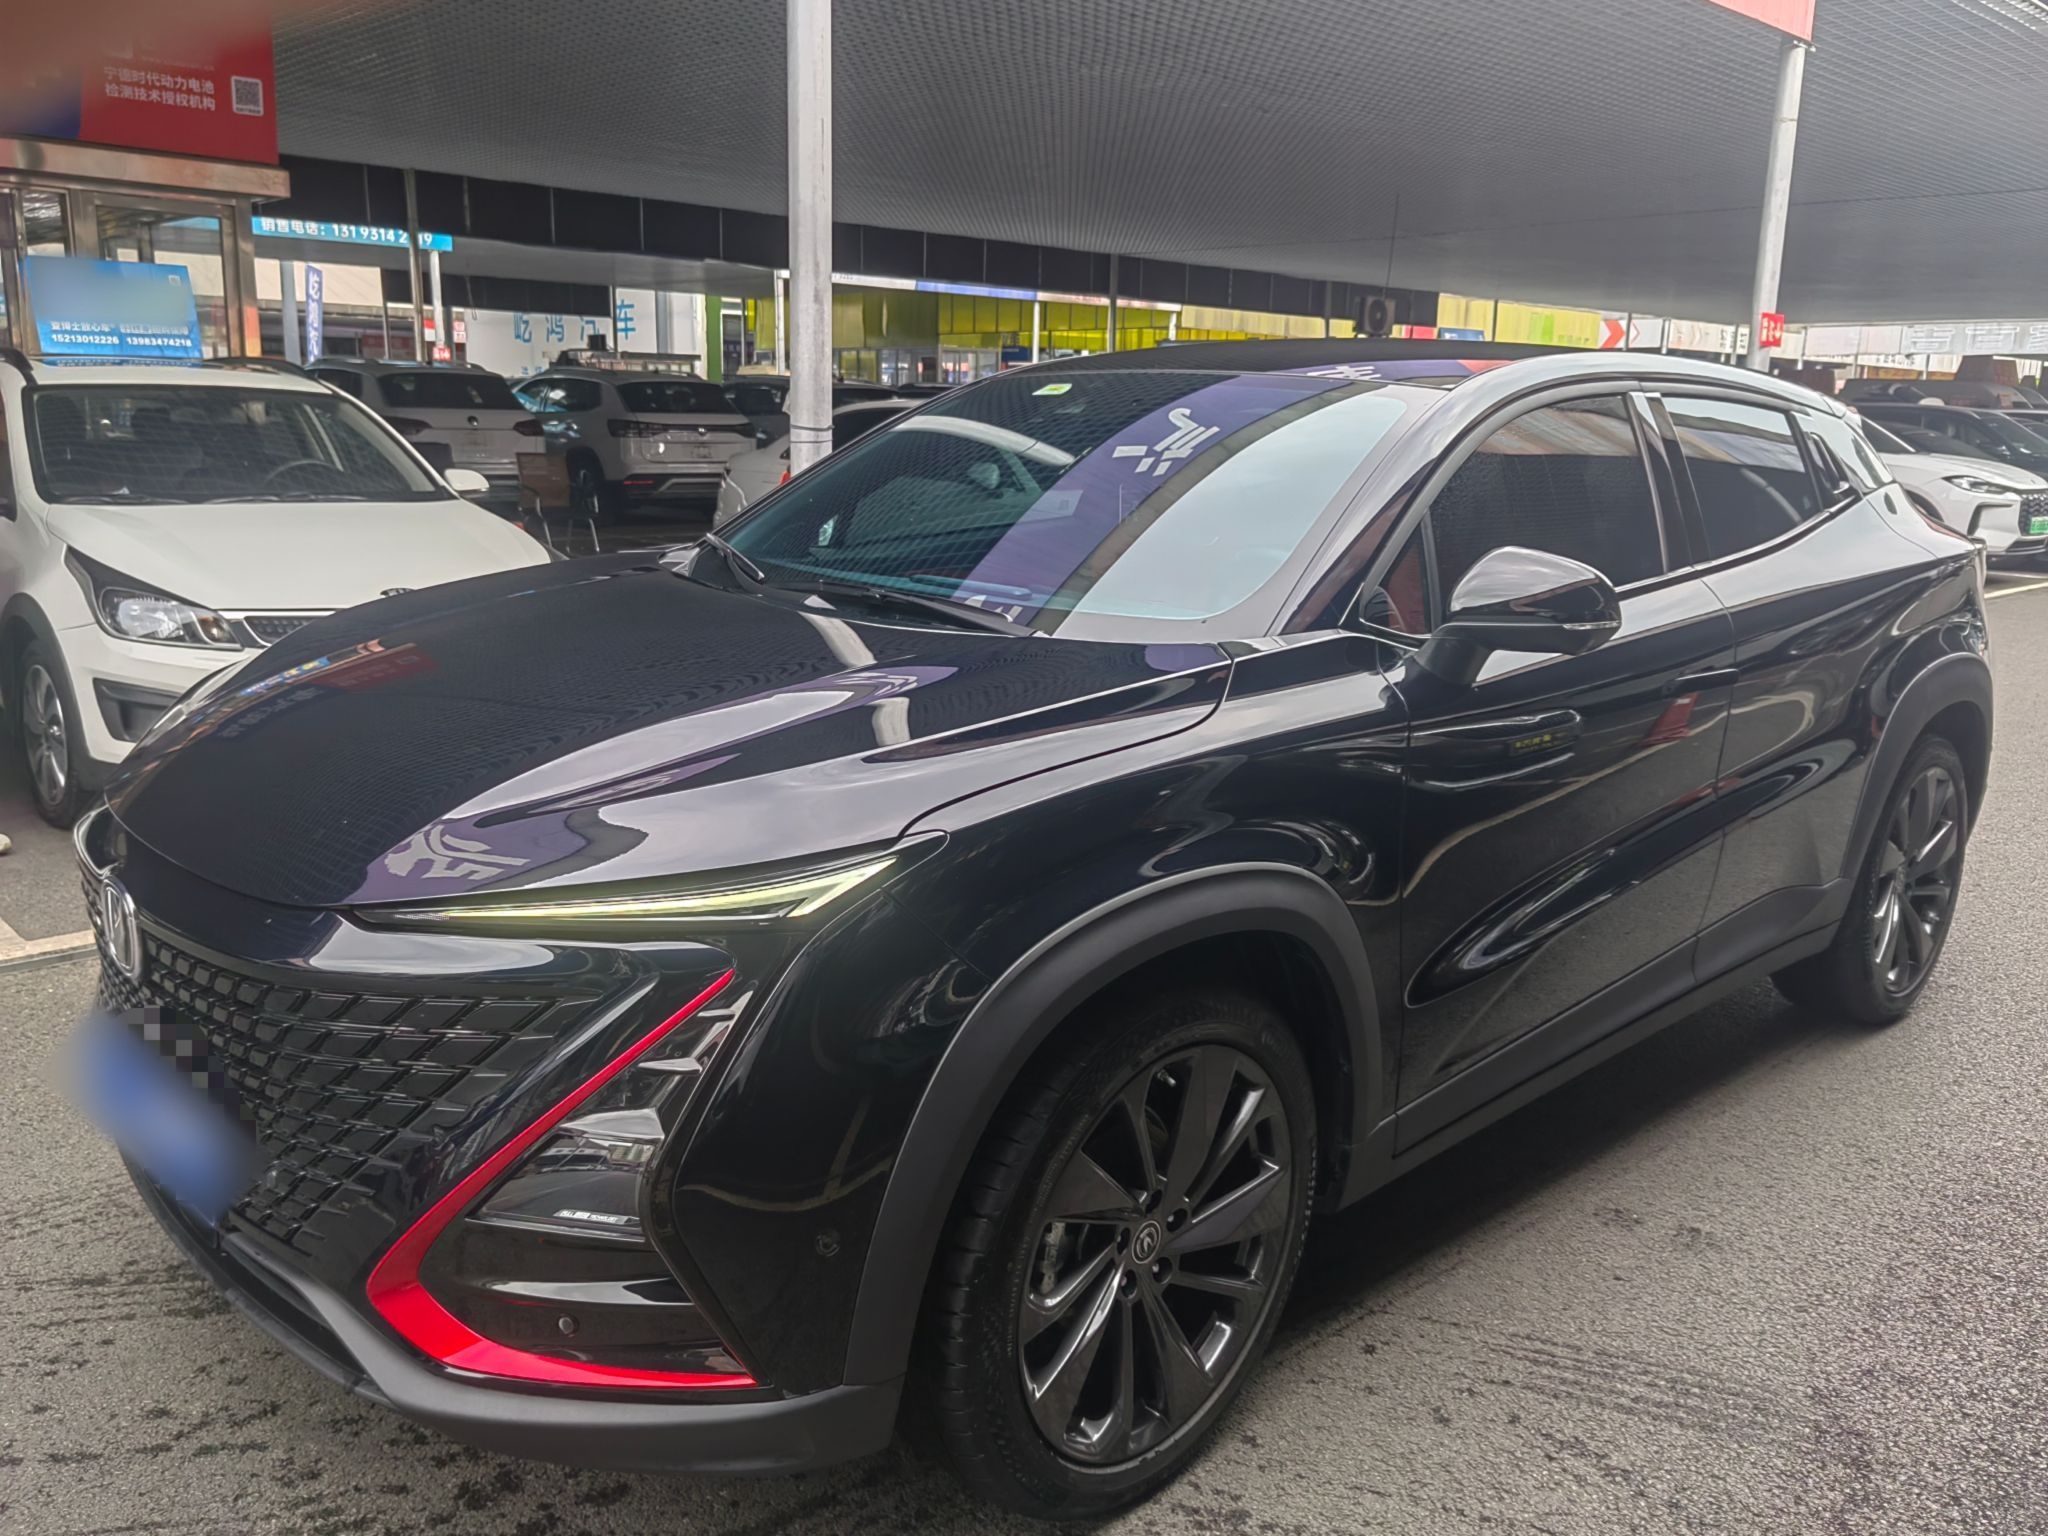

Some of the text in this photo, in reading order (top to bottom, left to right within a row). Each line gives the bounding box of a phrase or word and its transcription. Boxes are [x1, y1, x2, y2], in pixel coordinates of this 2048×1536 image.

[105, 83, 216, 111] 检测技术授权机构
[361, 227, 395, 242] 9314
[52, 334, 120, 345] 15213012226
